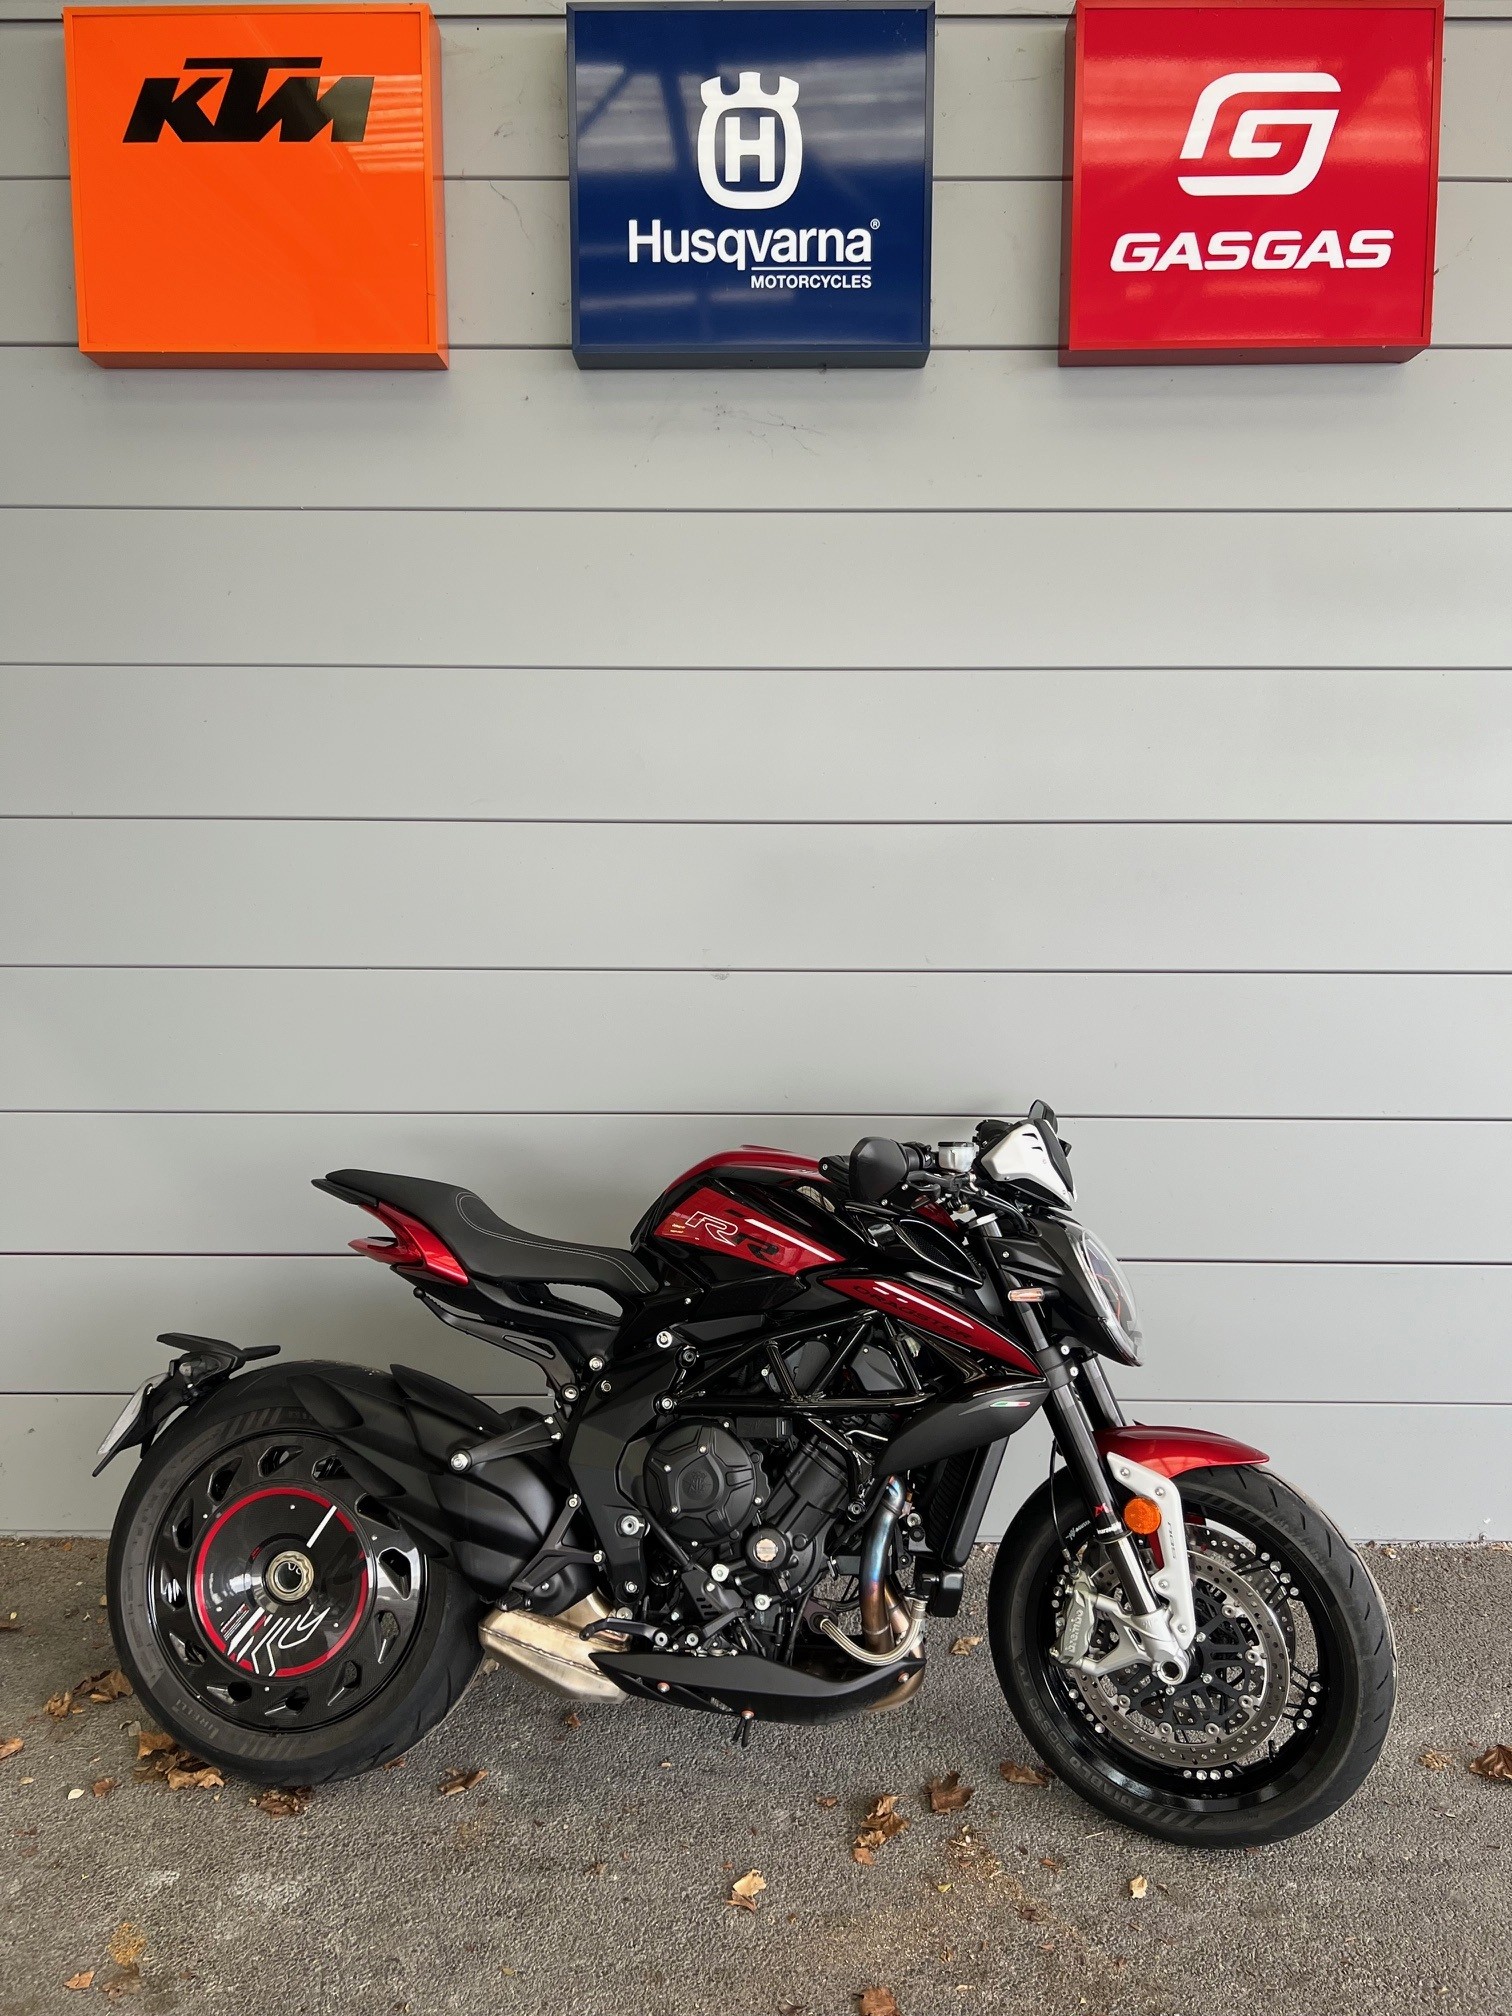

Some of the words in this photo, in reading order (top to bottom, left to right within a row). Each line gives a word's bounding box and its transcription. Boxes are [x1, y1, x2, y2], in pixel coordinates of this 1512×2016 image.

[122, 57, 375, 143] KTM
[725, 116, 776, 183] H
[1110, 229, 1395, 272] GASGAS
[750, 275, 872, 289] MOTORCYCLES
[853, 1285, 974, 1340] DRAGSTER
[1064, 1609, 1084, 1654] brembo
[1028, 1698, 1065, 1753] ROSSO
[1069, 1756, 1136, 1810] DIABLO
